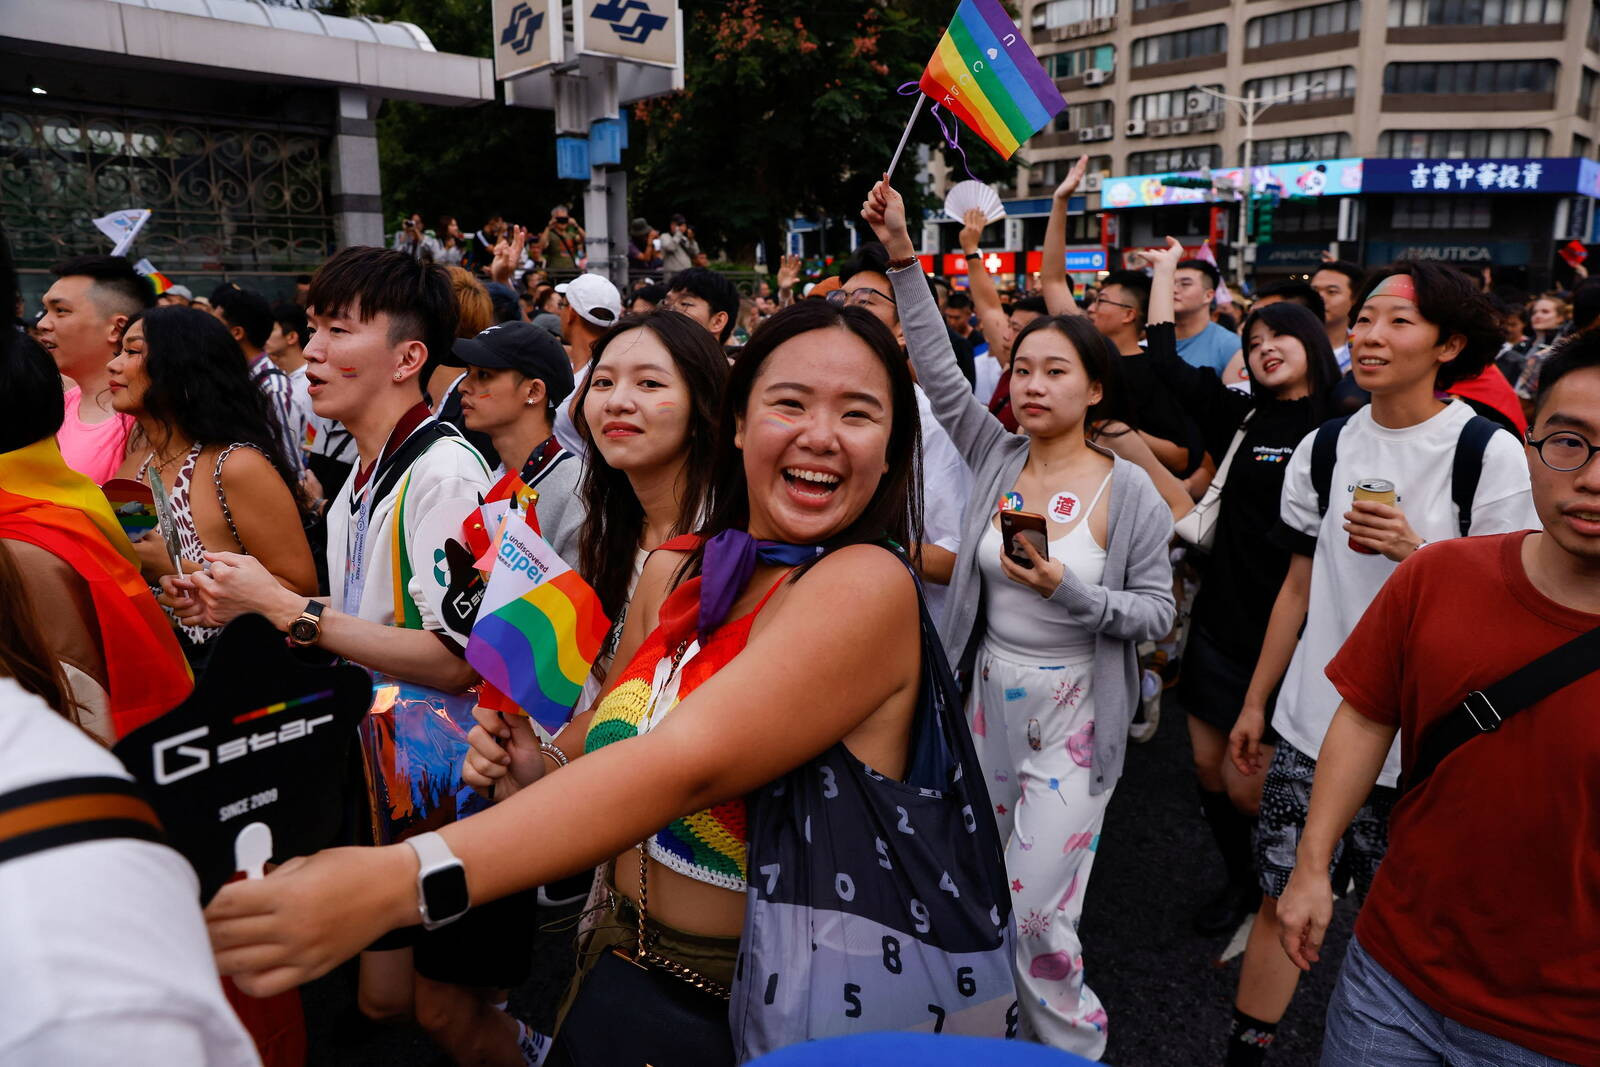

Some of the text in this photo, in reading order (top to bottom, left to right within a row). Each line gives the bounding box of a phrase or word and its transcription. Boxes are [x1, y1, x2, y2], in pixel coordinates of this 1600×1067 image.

[1410, 161, 1543, 190] 吉富中華投資
[1407, 246, 1491, 262] NAUTICA
[509, 535, 549, 573] undiscovered
[819, 766, 839, 799] 3
[219, 788, 278, 822] SINCE 2009
[759, 863, 781, 896] 7
[835, 872, 856, 902] 0
[910, 899, 931, 933] 9
[881, 935, 902, 975] 8
[956, 967, 977, 997] 6
[844, 983, 862, 1018] 5
[928, 1003, 945, 1034] 7
